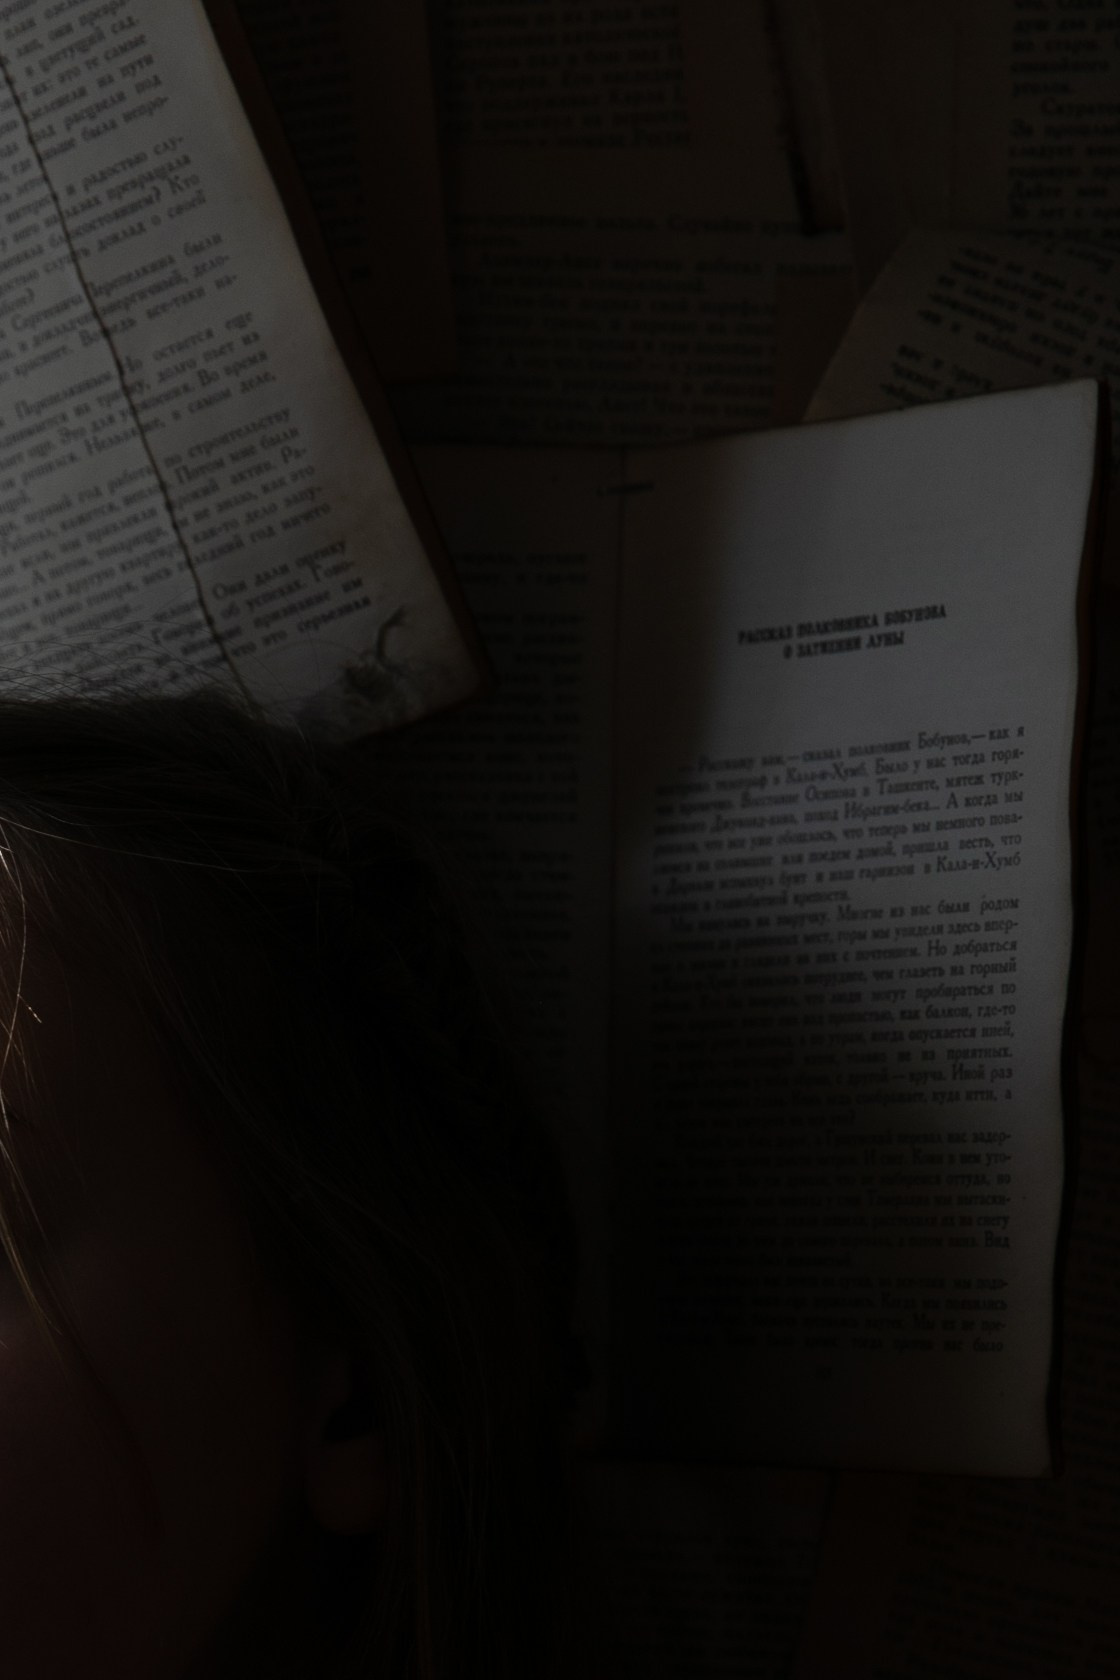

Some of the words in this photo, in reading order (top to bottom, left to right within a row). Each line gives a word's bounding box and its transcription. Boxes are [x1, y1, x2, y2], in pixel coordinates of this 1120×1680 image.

[166, 174, 200, 194] Кто
[196, 368, 219, 387] Во
[173, 455, 225, 484] Потом
[951, 752, 985, 765] тогда
[945, 791, 958, 809] А
[963, 793, 998, 807] когда
[926, 938, 947, 957] Но
[952, 939, 1017, 956] добраться
